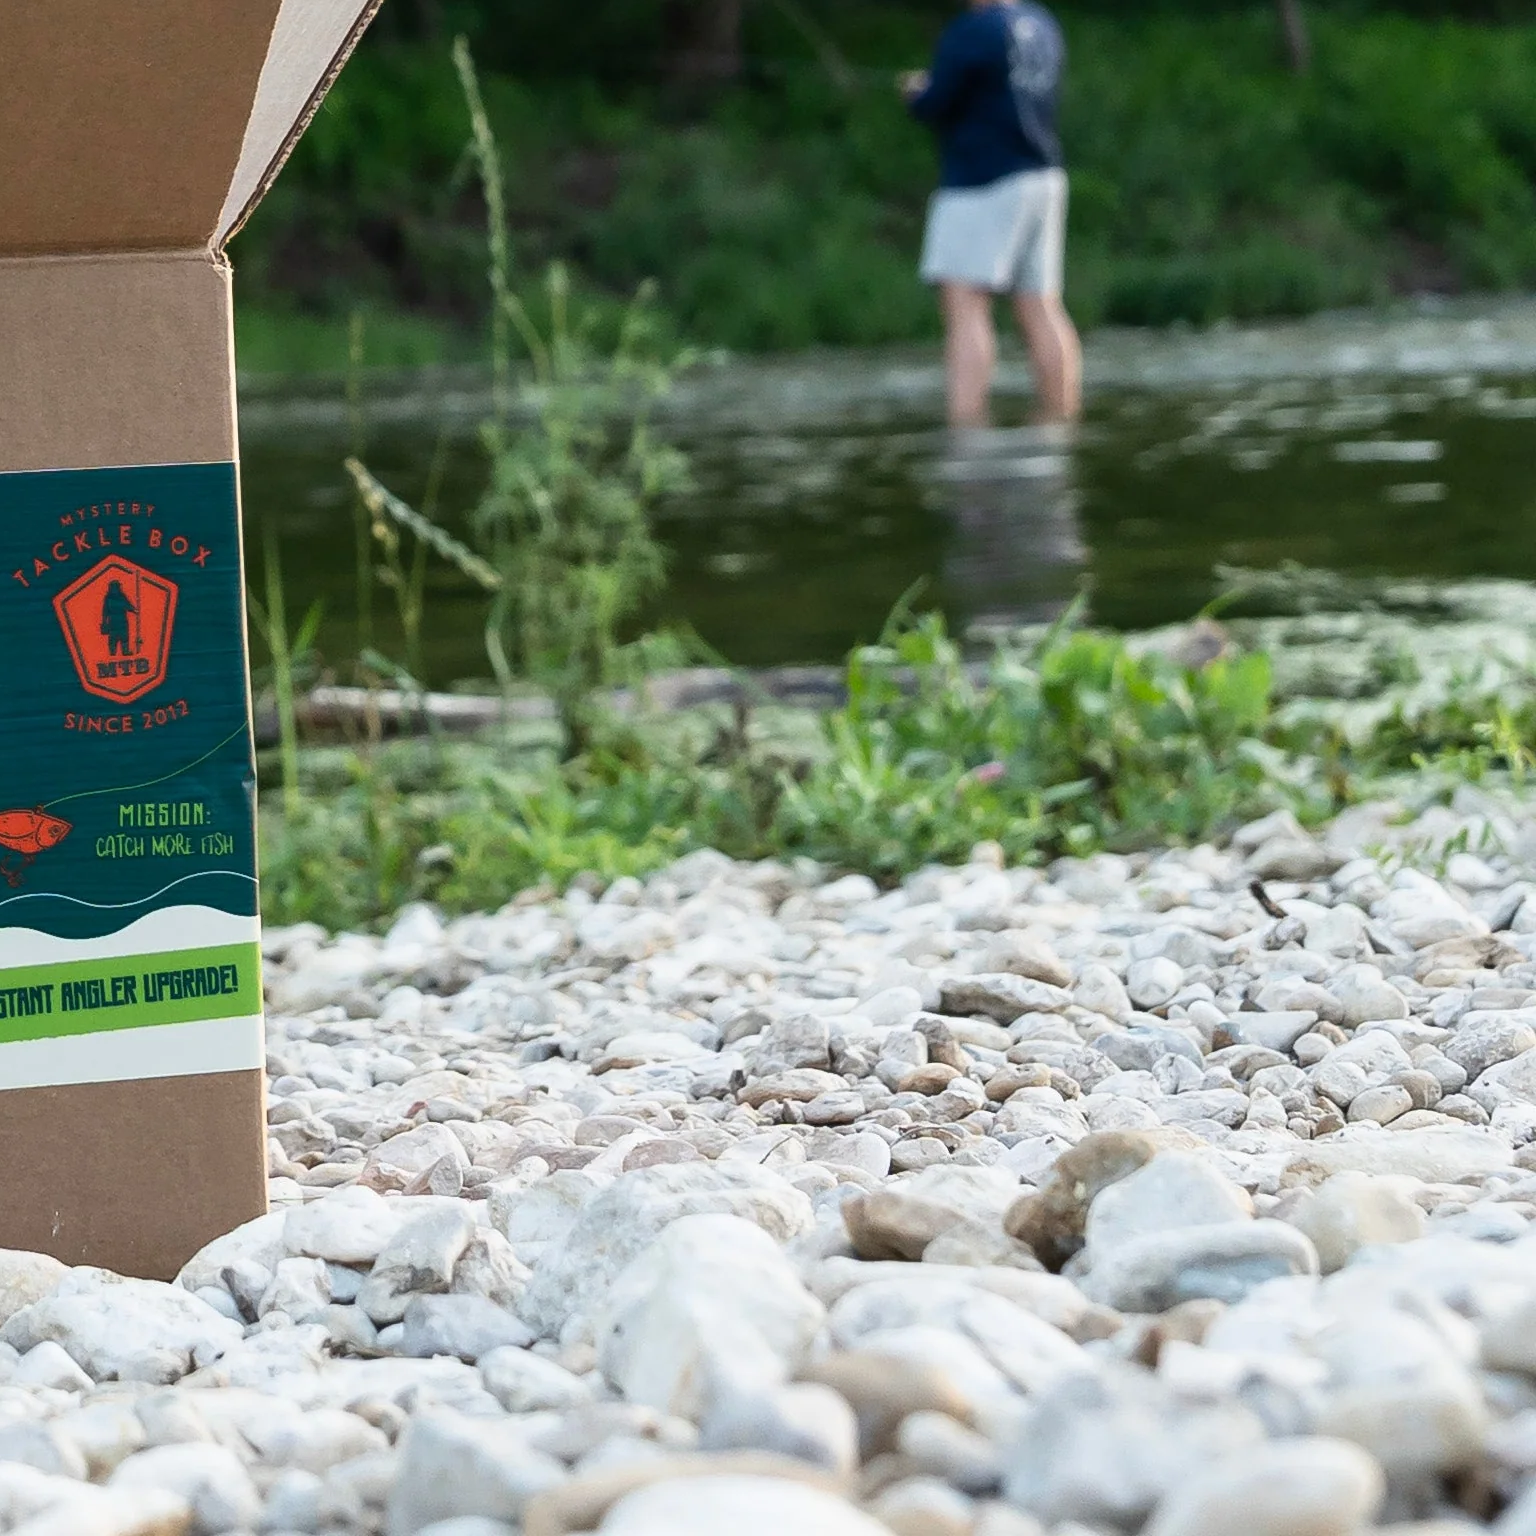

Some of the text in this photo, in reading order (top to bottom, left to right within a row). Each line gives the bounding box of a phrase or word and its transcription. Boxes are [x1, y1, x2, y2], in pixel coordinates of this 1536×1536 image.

[60, 503, 155, 526] MYSTERY
[12, 525, 212, 588] TACKLE BOX
[96, 657, 150, 678] MTB
[64, 699, 189, 733] SINCE 2012
[119, 802, 211, 827] MISSION:
[95, 832, 234, 859] CATCH MORE FISH
[61, 975, 137, 1012] ANGLER
[143, 964, 238, 1003] UPGRADE!
